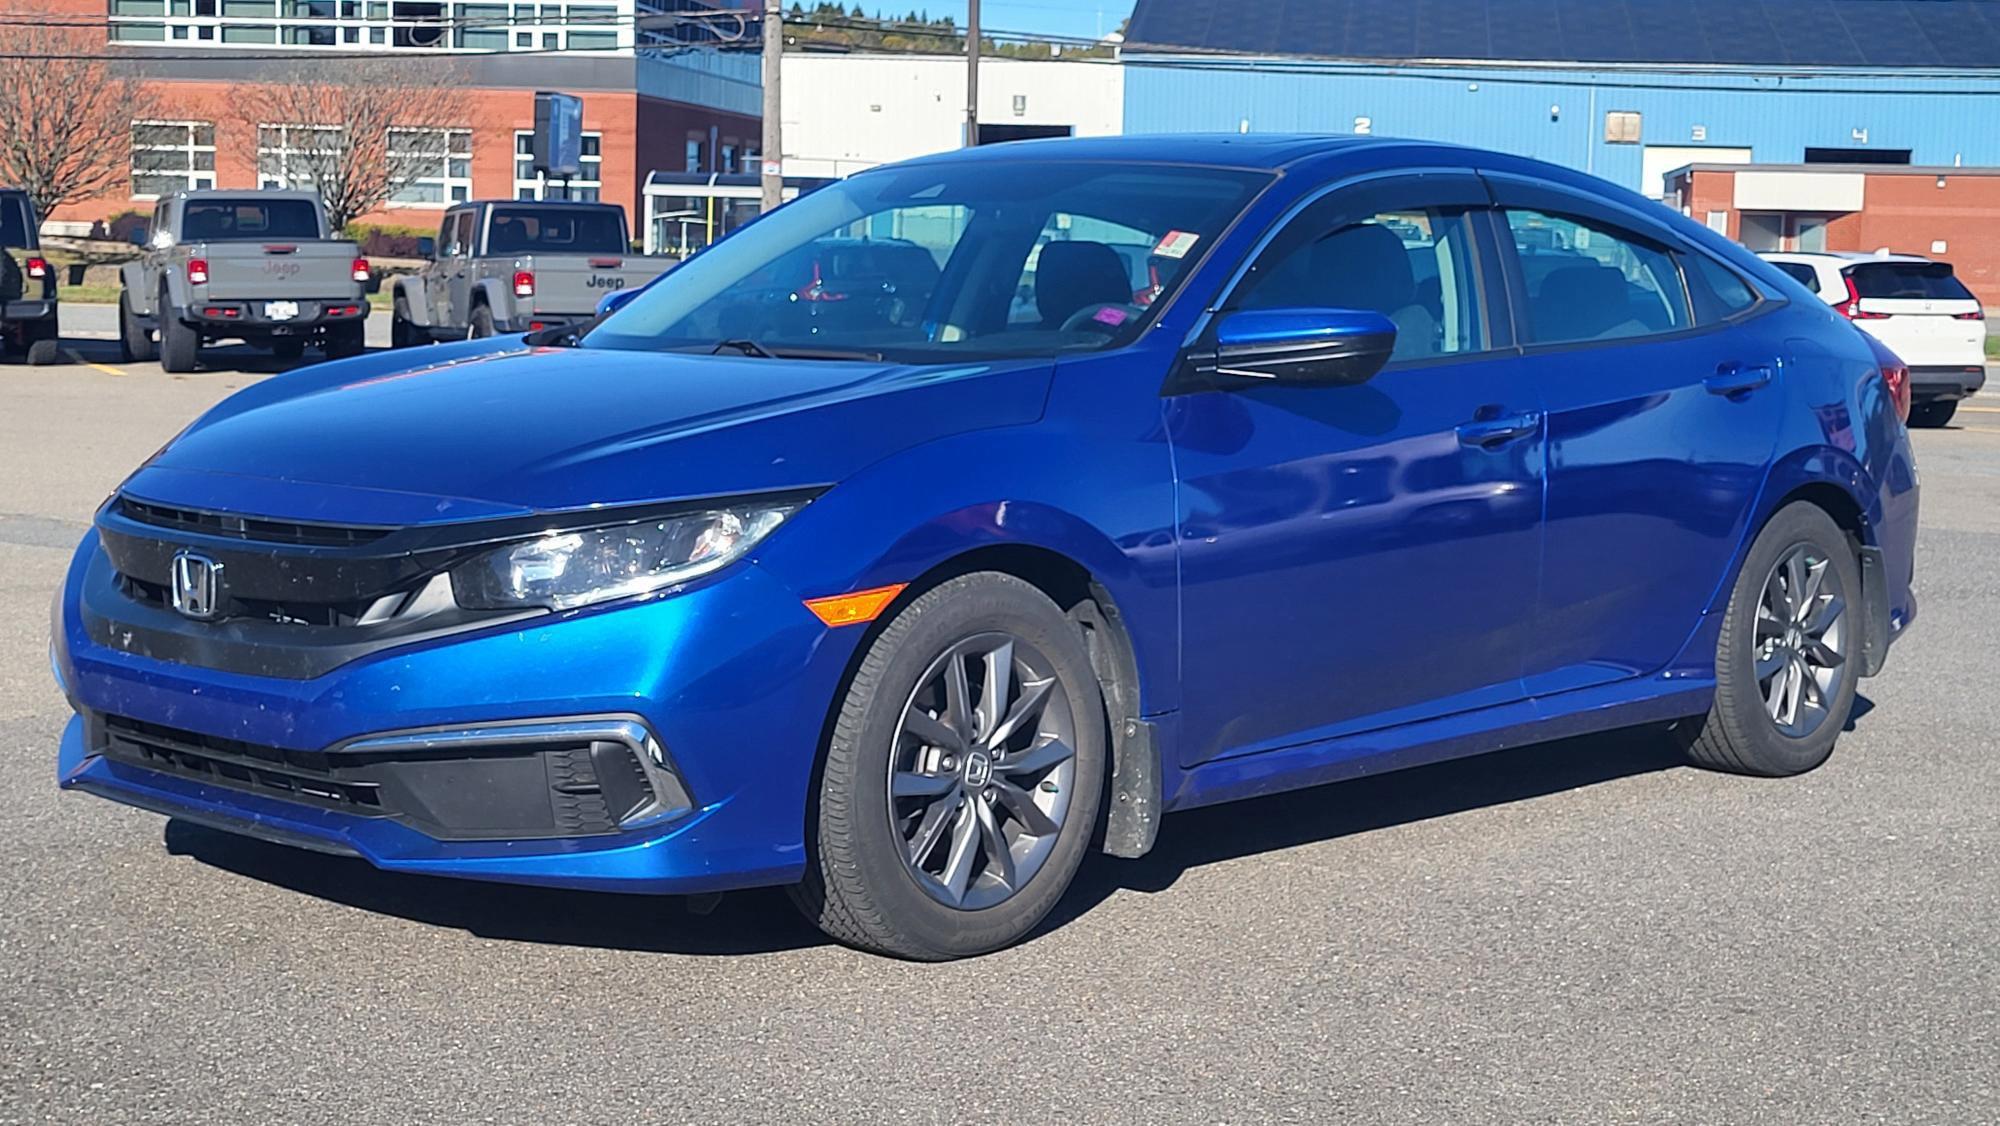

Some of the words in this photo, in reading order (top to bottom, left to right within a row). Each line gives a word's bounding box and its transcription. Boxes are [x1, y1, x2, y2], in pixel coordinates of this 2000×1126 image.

[1354, 117, 1371, 134] 2
[1691, 126, 1706, 140] 3
[1852, 128, 1868, 144] 4
[586, 273, 625, 290] Jeep
